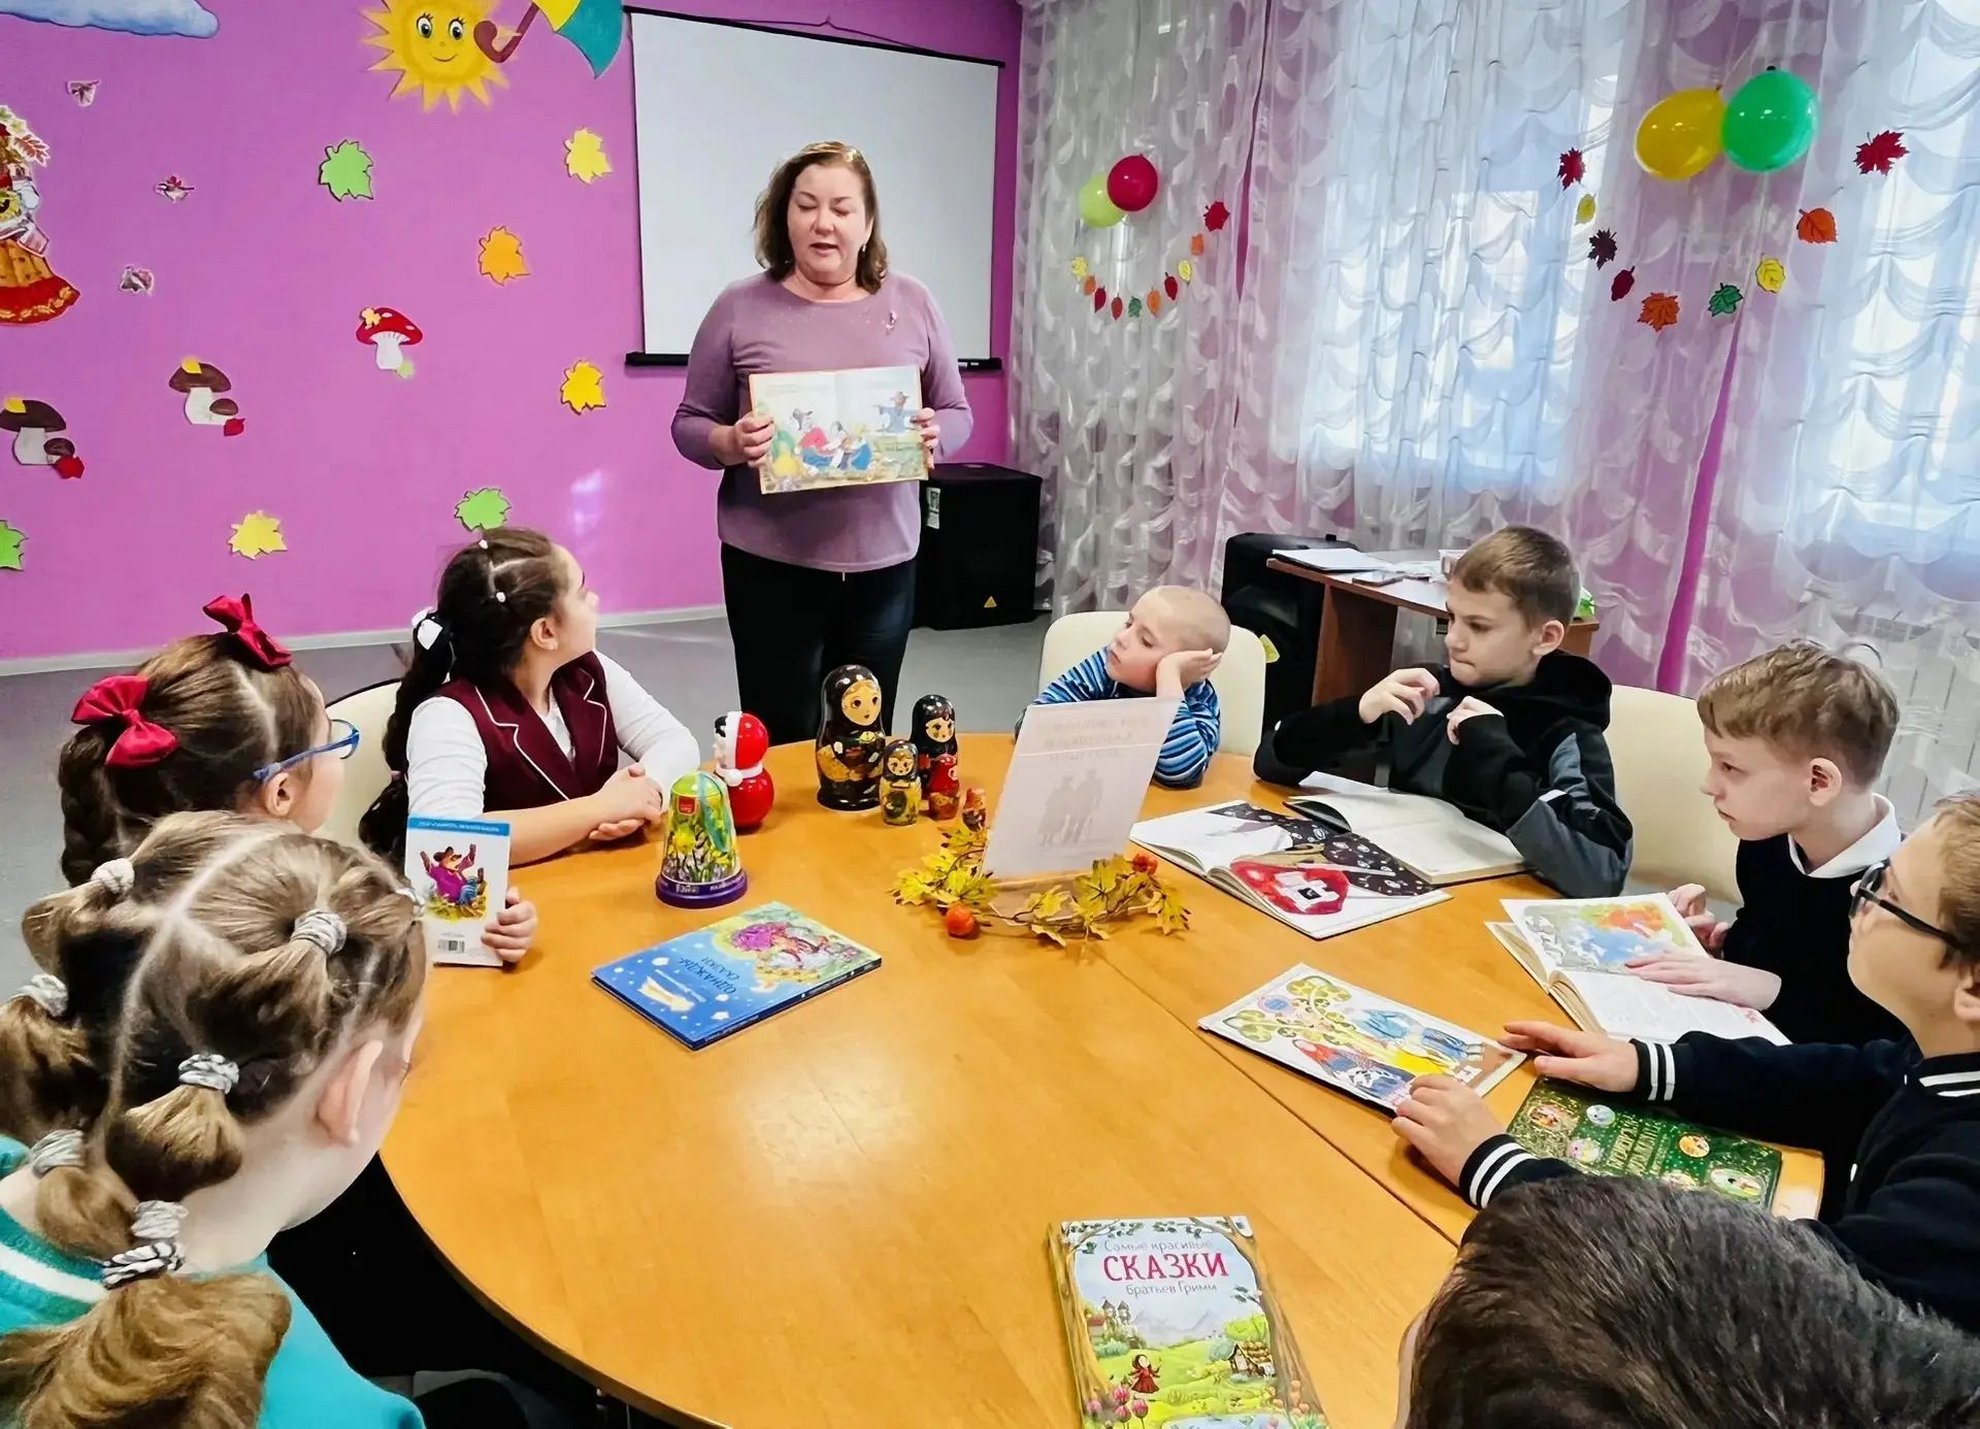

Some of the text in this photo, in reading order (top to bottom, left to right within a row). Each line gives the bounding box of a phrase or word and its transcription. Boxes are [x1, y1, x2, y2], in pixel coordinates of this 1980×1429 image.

[1104, 1240, 1147, 1252] Самые
[1103, 1252, 1229, 1282] СКАЗКИ
[1178, 1281, 1217, 1296] Гримм
